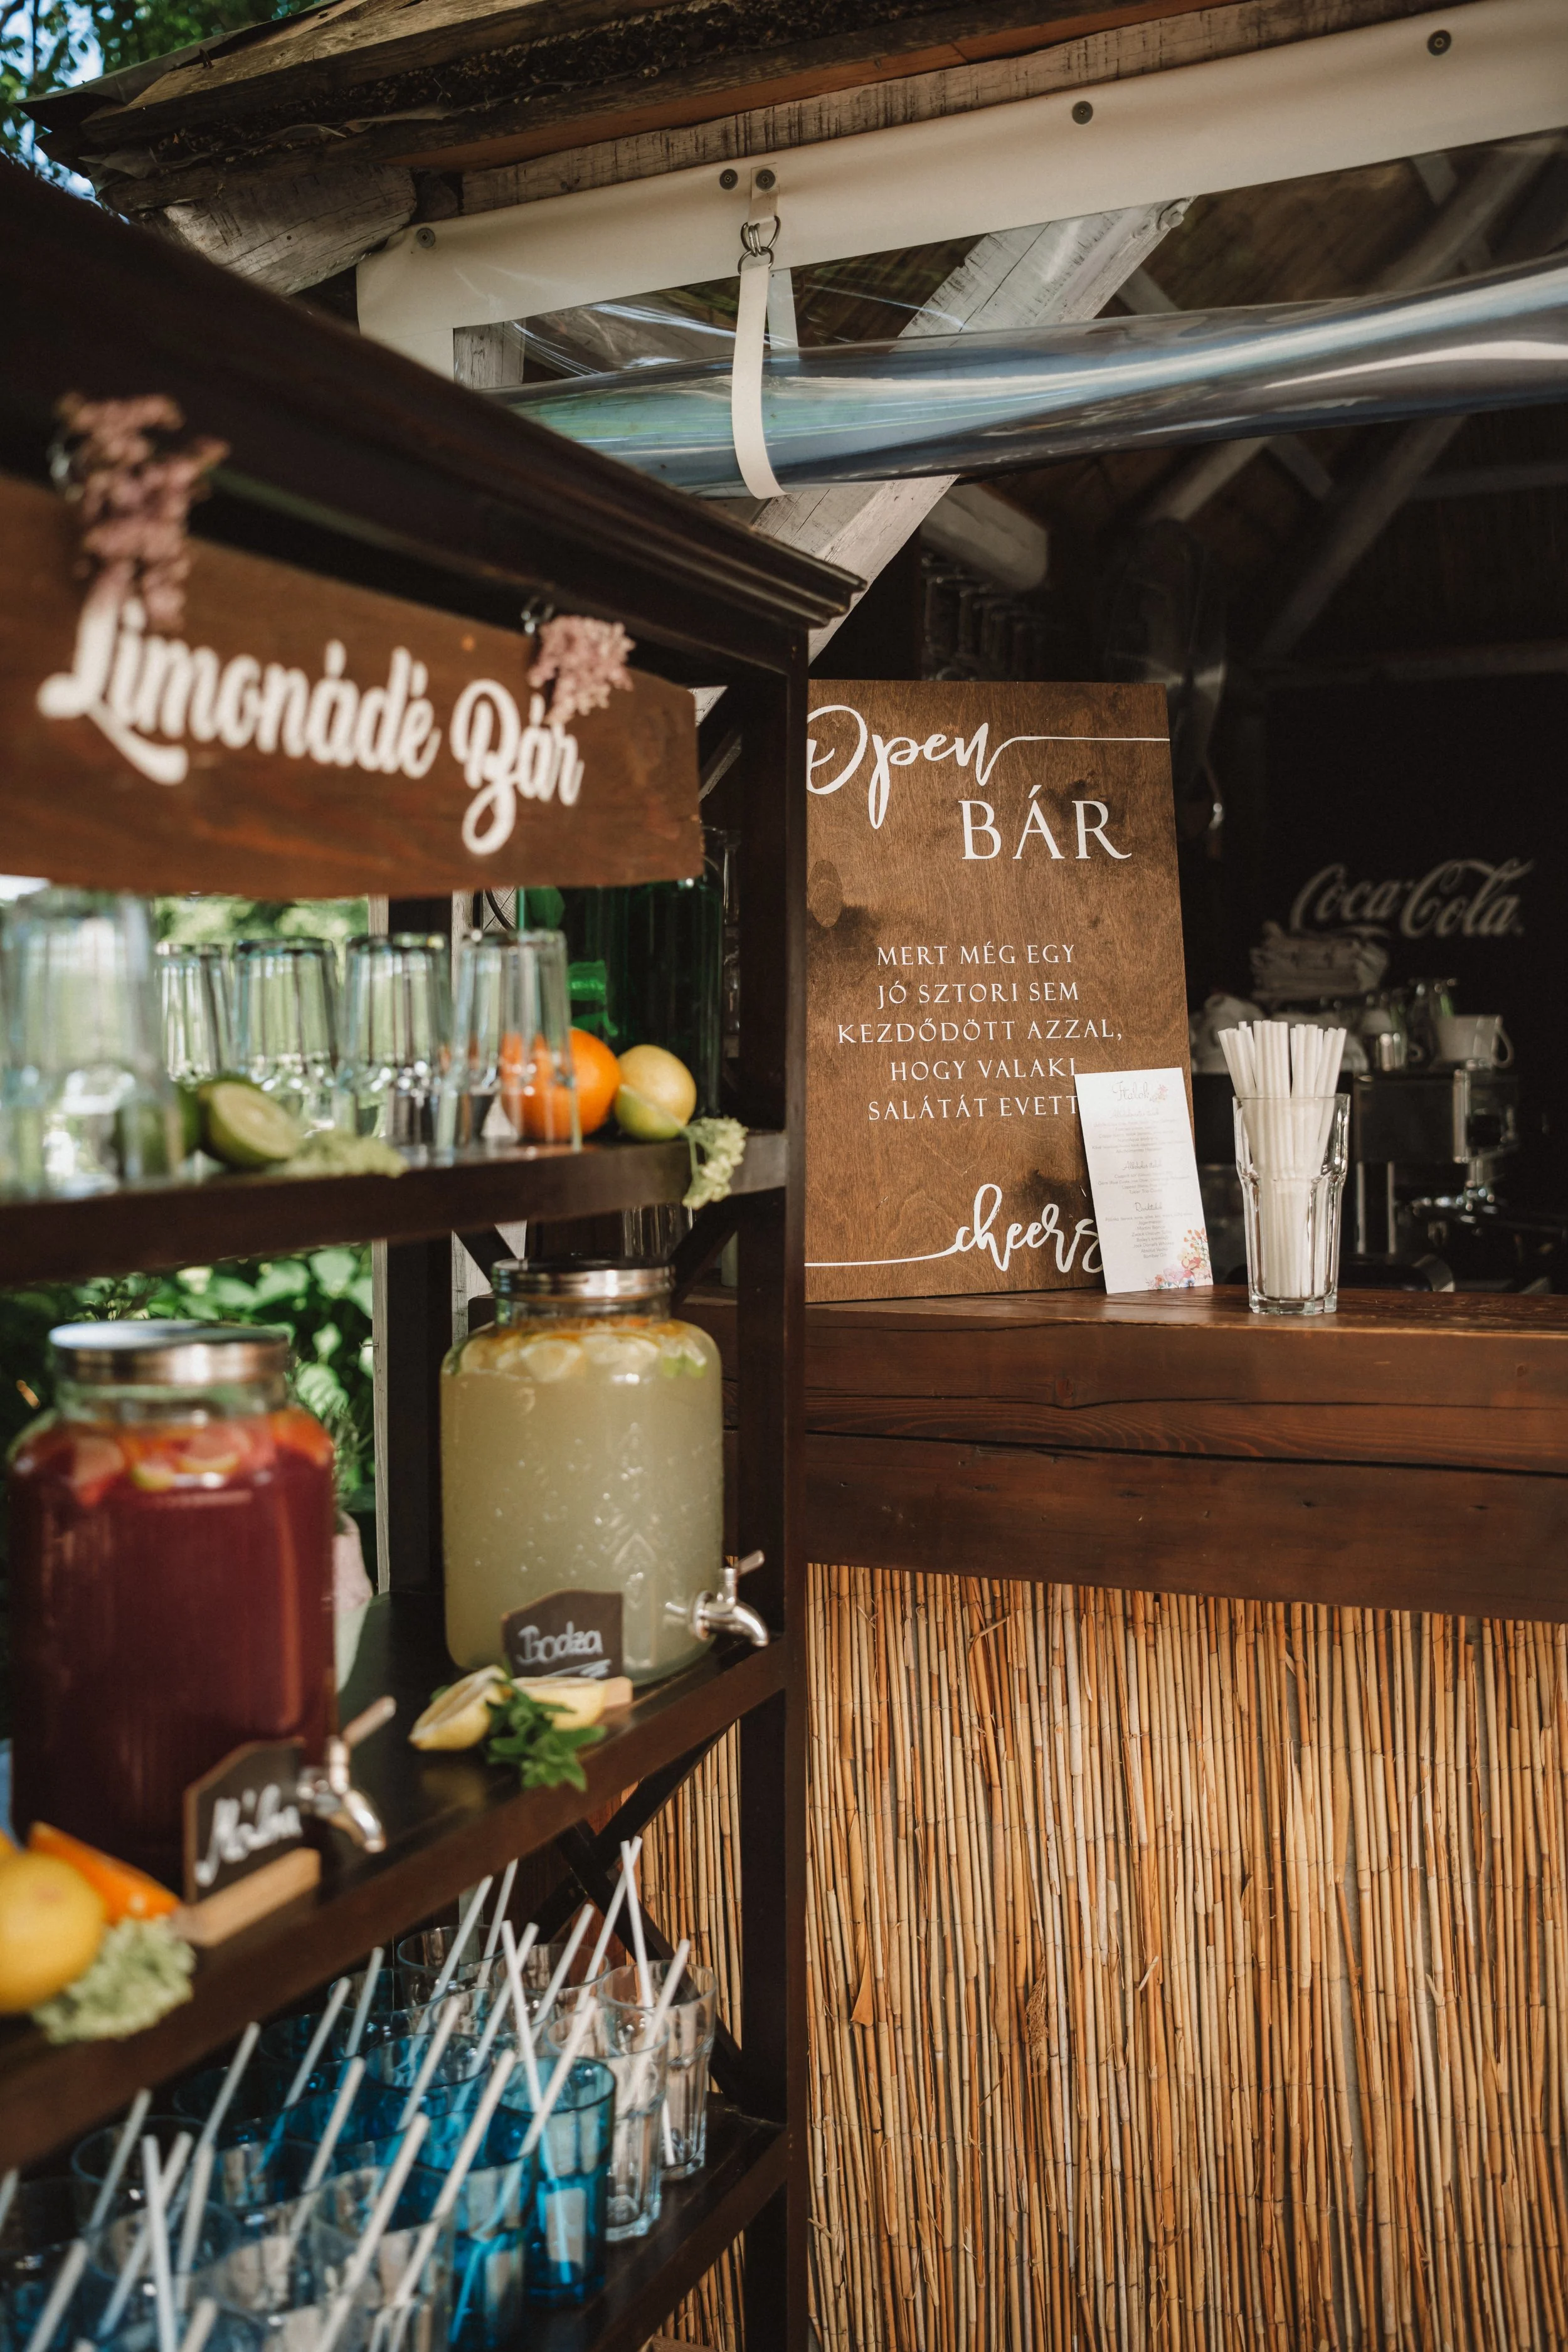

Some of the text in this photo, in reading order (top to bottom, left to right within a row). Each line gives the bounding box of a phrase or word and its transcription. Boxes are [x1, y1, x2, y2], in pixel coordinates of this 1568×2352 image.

[37, 577, 440, 785] Limonádé
[807, 704, 1009, 830] Open
[958, 784, 1131, 859] BÁR
[877, 941, 1075, 965] MERT MÉG EGY
[877, 980, 1079, 1010] JÓ SZTORI SEM
[838, 1018, 1122, 1043] KEZDŐDÖTT AZZAL,
[891, 1057, 1074, 1081] HOGY VALAKI
[869, 1094, 1078, 1120] SALÁTÁT EVETT
[953, 1184, 1103, 1273] cheers
